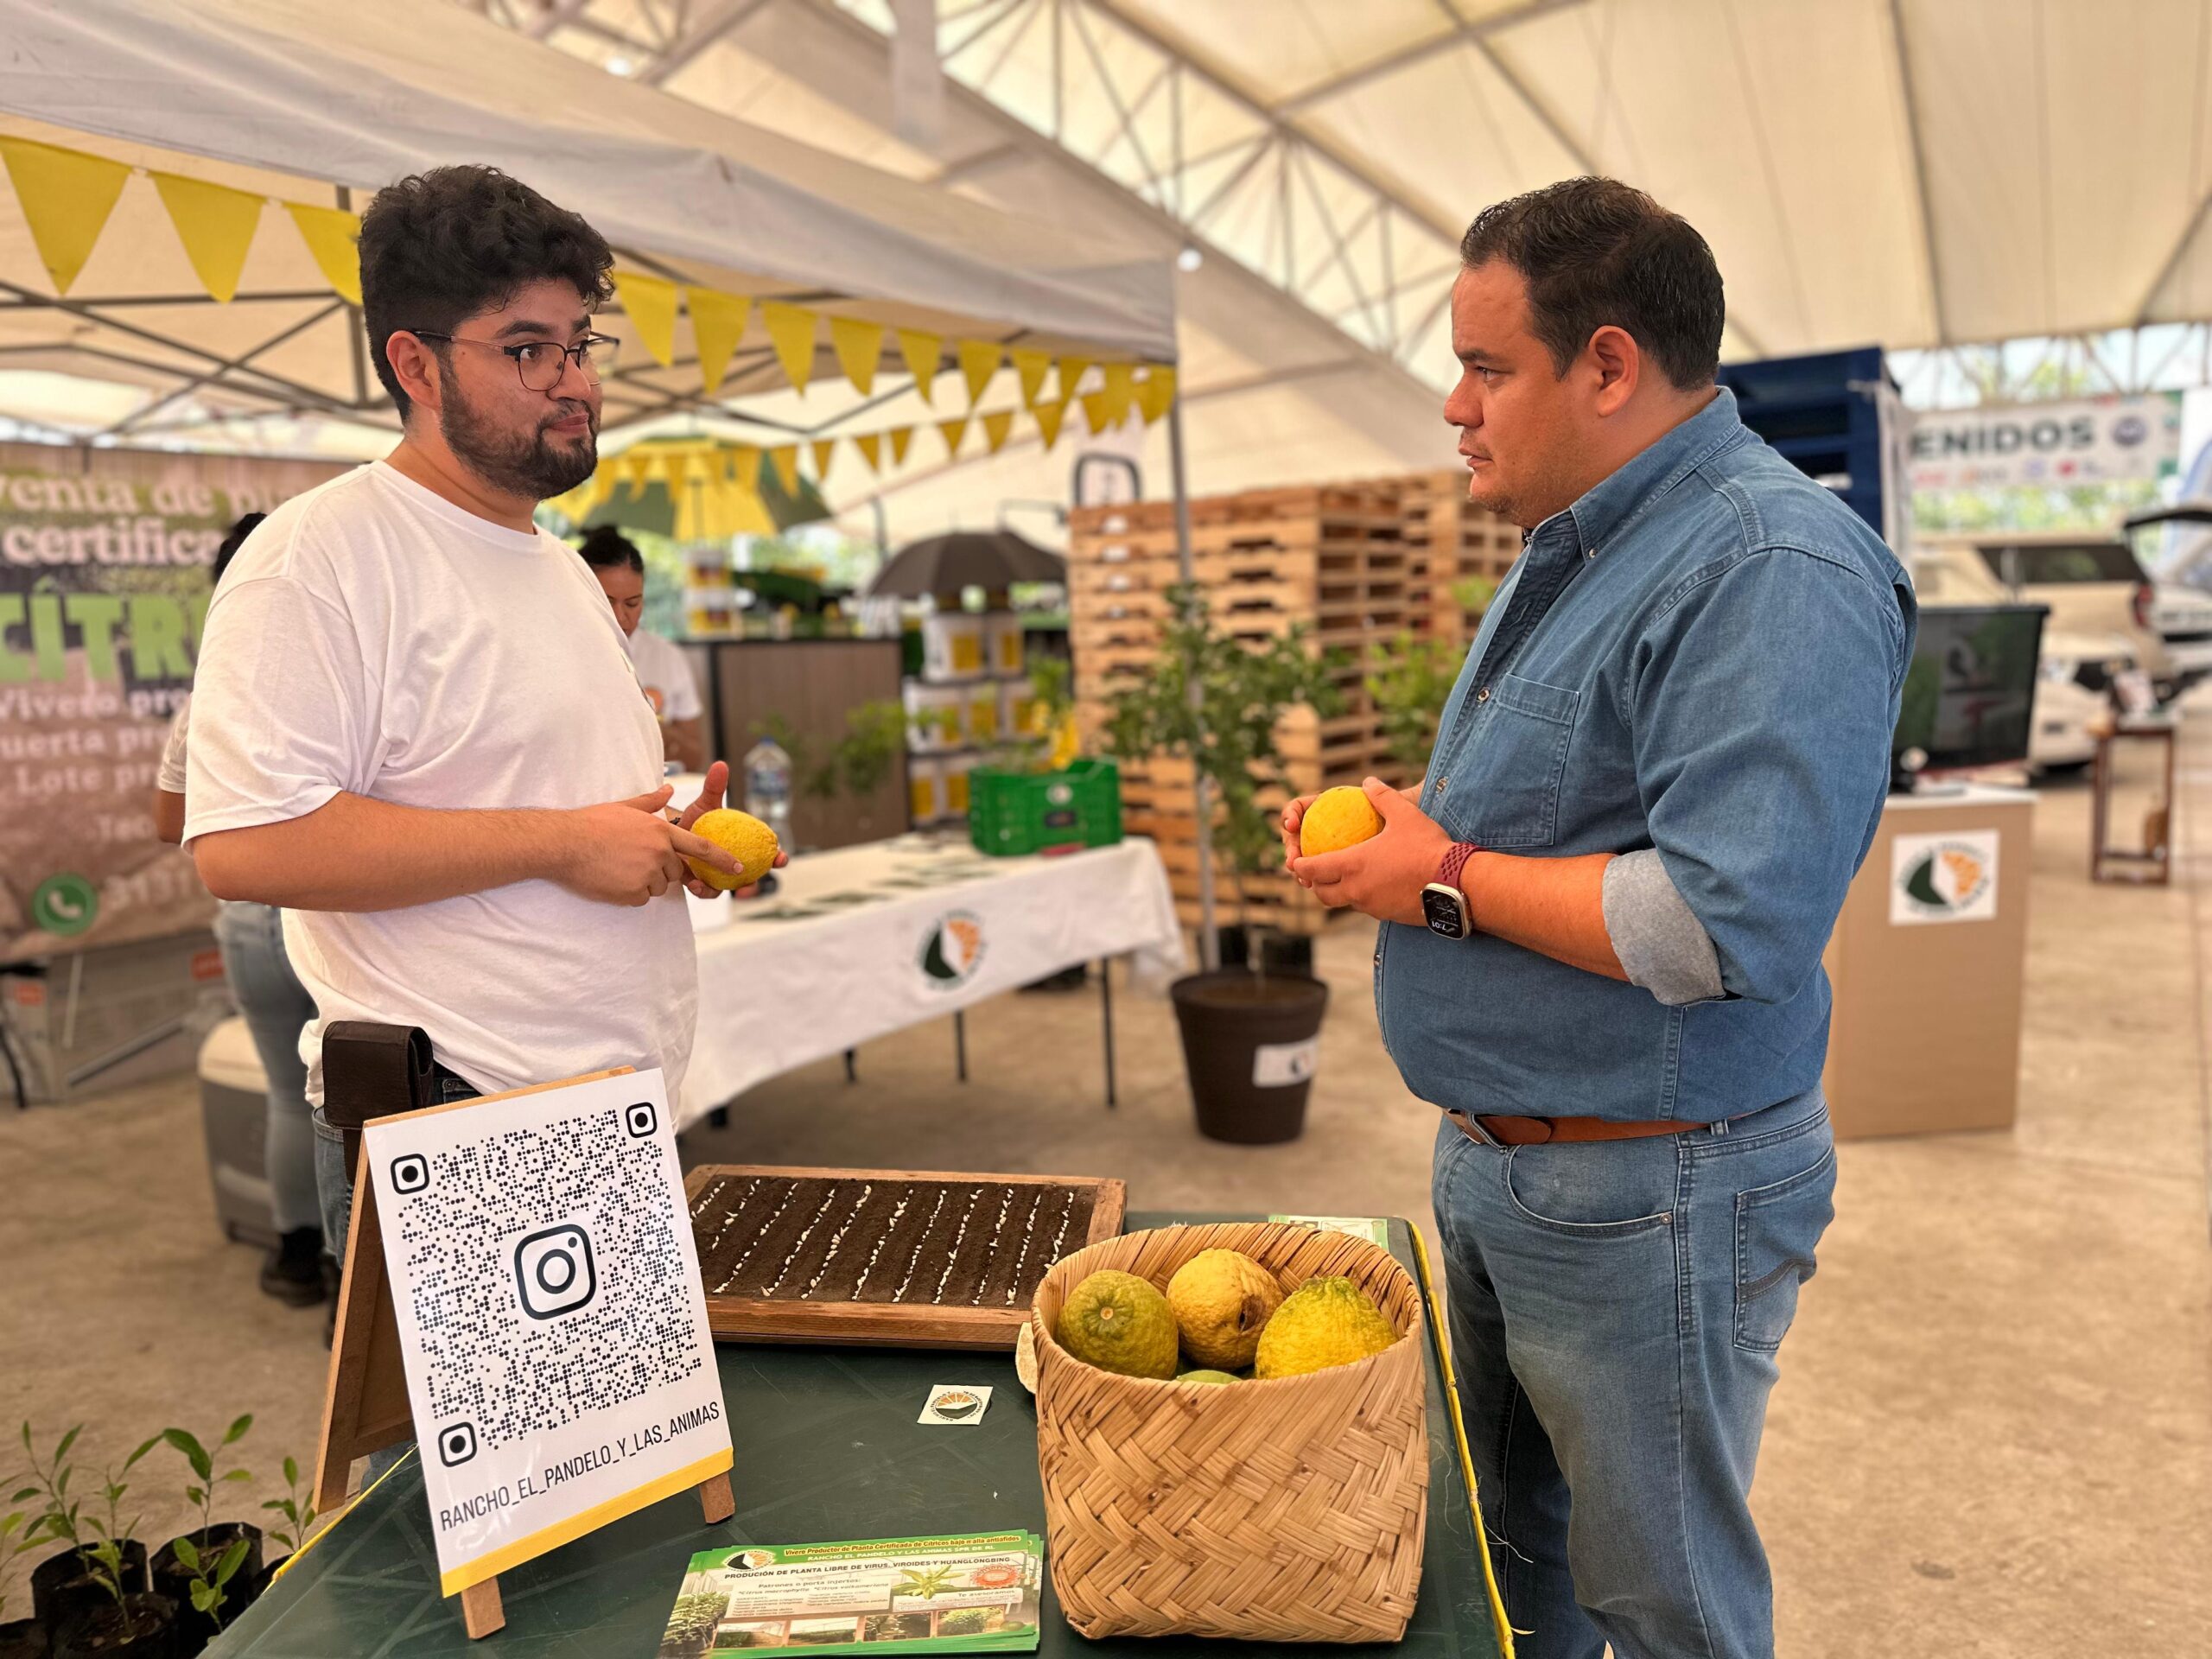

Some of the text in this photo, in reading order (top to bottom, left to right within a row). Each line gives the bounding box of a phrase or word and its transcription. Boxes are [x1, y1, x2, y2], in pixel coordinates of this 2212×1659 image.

[874, 1541, 912, 1550] Certificada
[724, 1571, 774, 1580] PRODUCIÓN
[790, 1567, 823, 1575] PLANTA
[940, 1556, 1011, 1565] HUANGLONGBING
